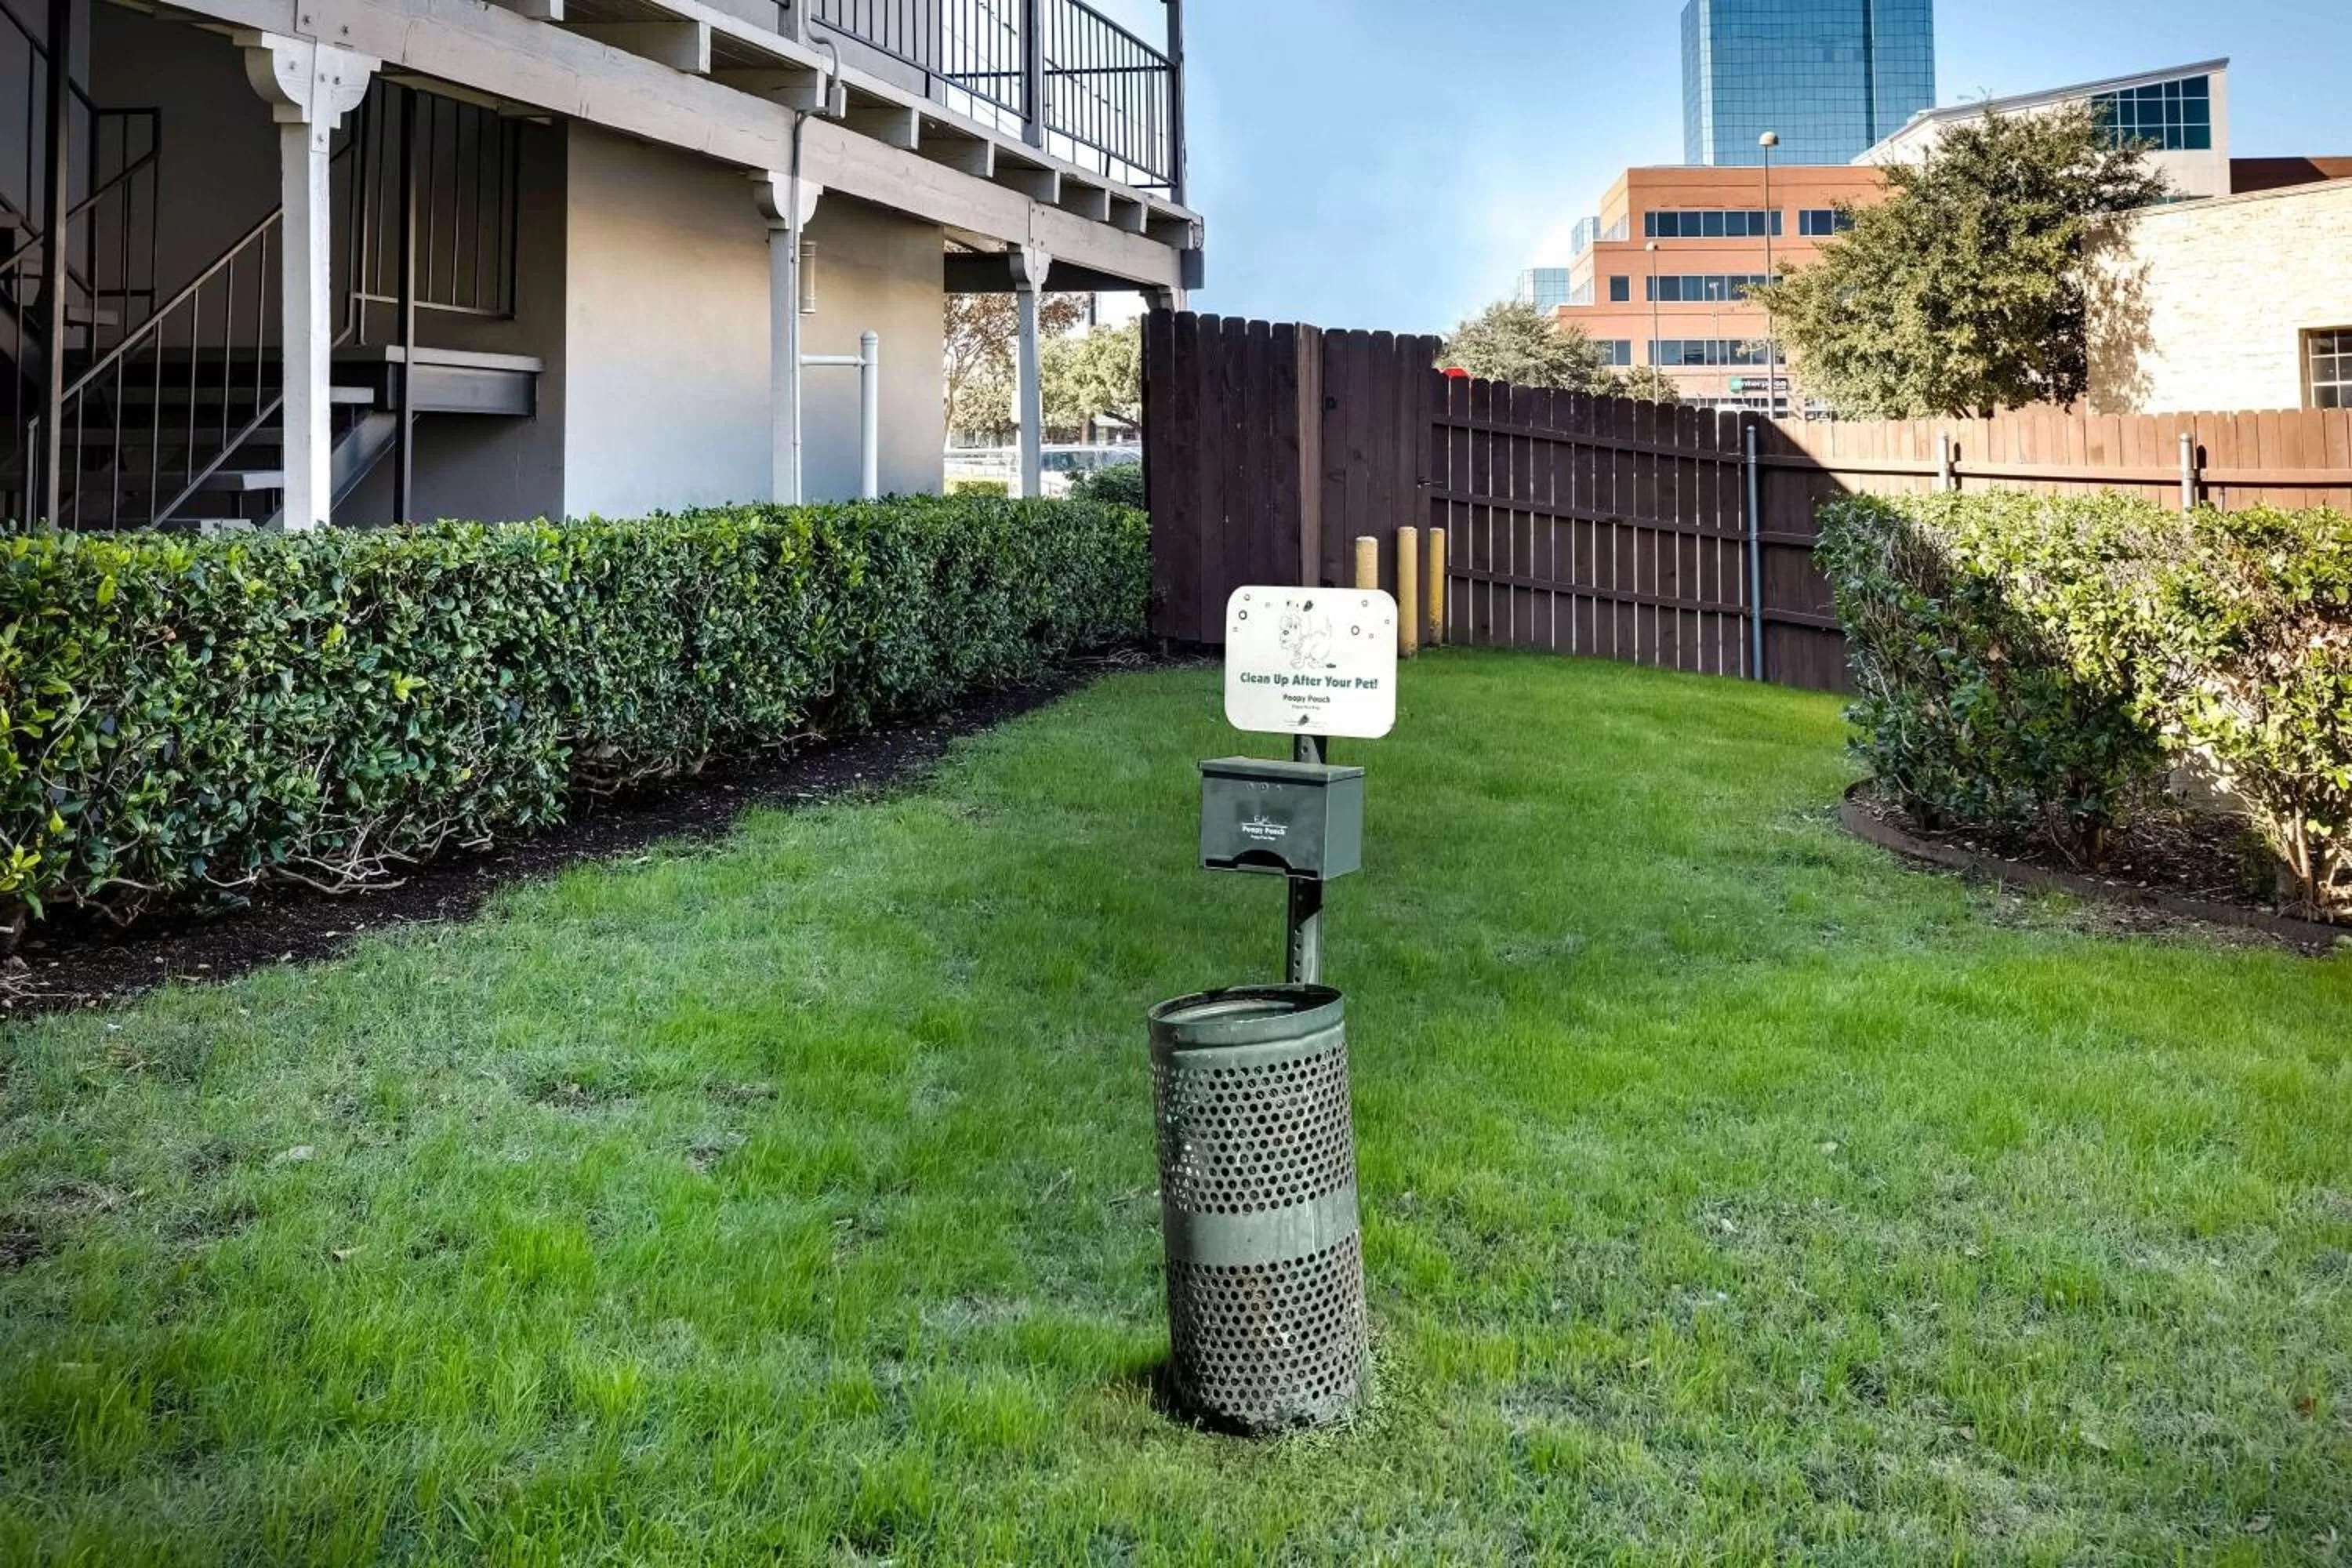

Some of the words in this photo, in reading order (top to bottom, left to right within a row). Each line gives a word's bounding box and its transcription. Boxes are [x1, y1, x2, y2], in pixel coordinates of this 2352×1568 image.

[1240, 672, 1270, 684] Clean
[1274, 673, 1289, 688] Up
[1291, 674, 1322, 686] After
[1325, 676, 1352, 688] Your
[1355, 677, 1377, 689] Pet!
